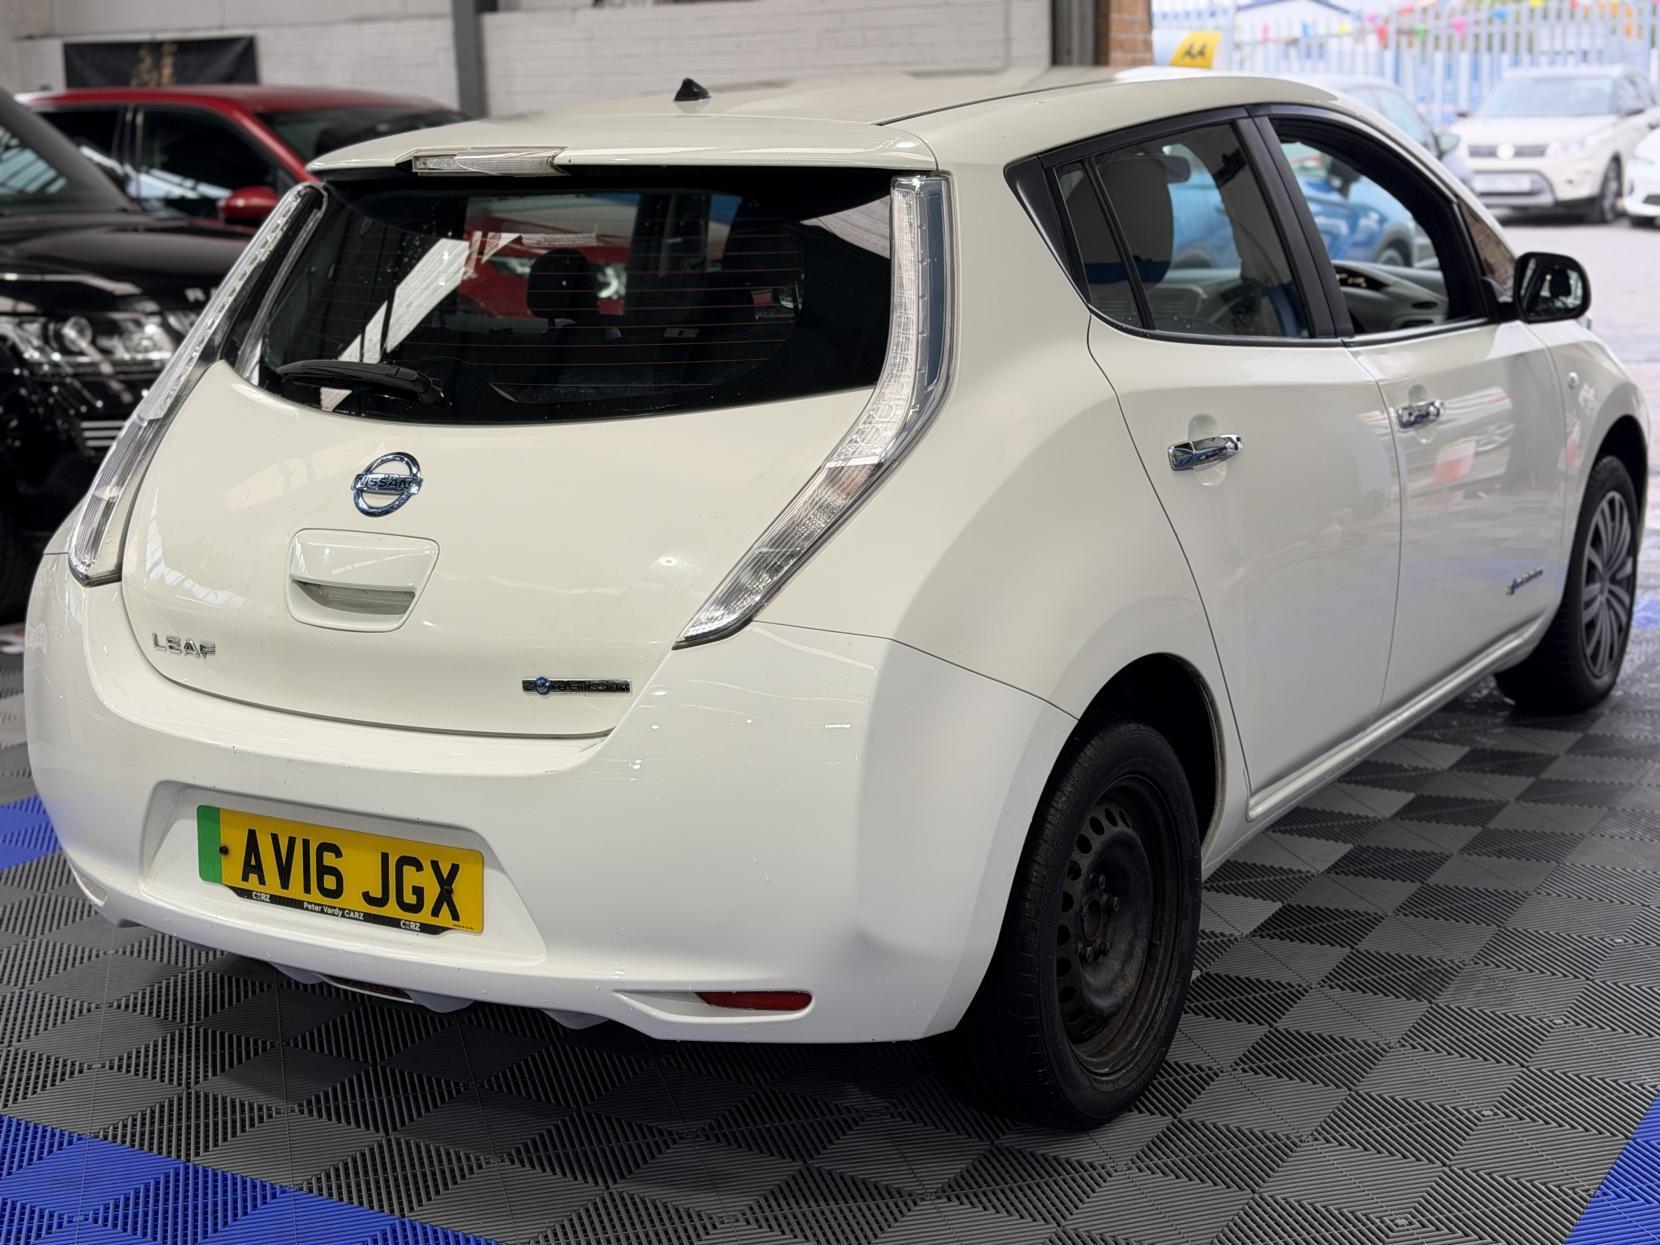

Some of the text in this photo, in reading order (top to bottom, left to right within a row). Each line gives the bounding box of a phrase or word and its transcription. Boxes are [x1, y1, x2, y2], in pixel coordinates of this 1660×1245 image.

[355, 475, 410, 489] NISSAN
[152, 632, 216, 659] LEAF
[241, 828, 460, 922] AV16 JGX
[303, 901, 365, 920] Peter Vardy CARZ
